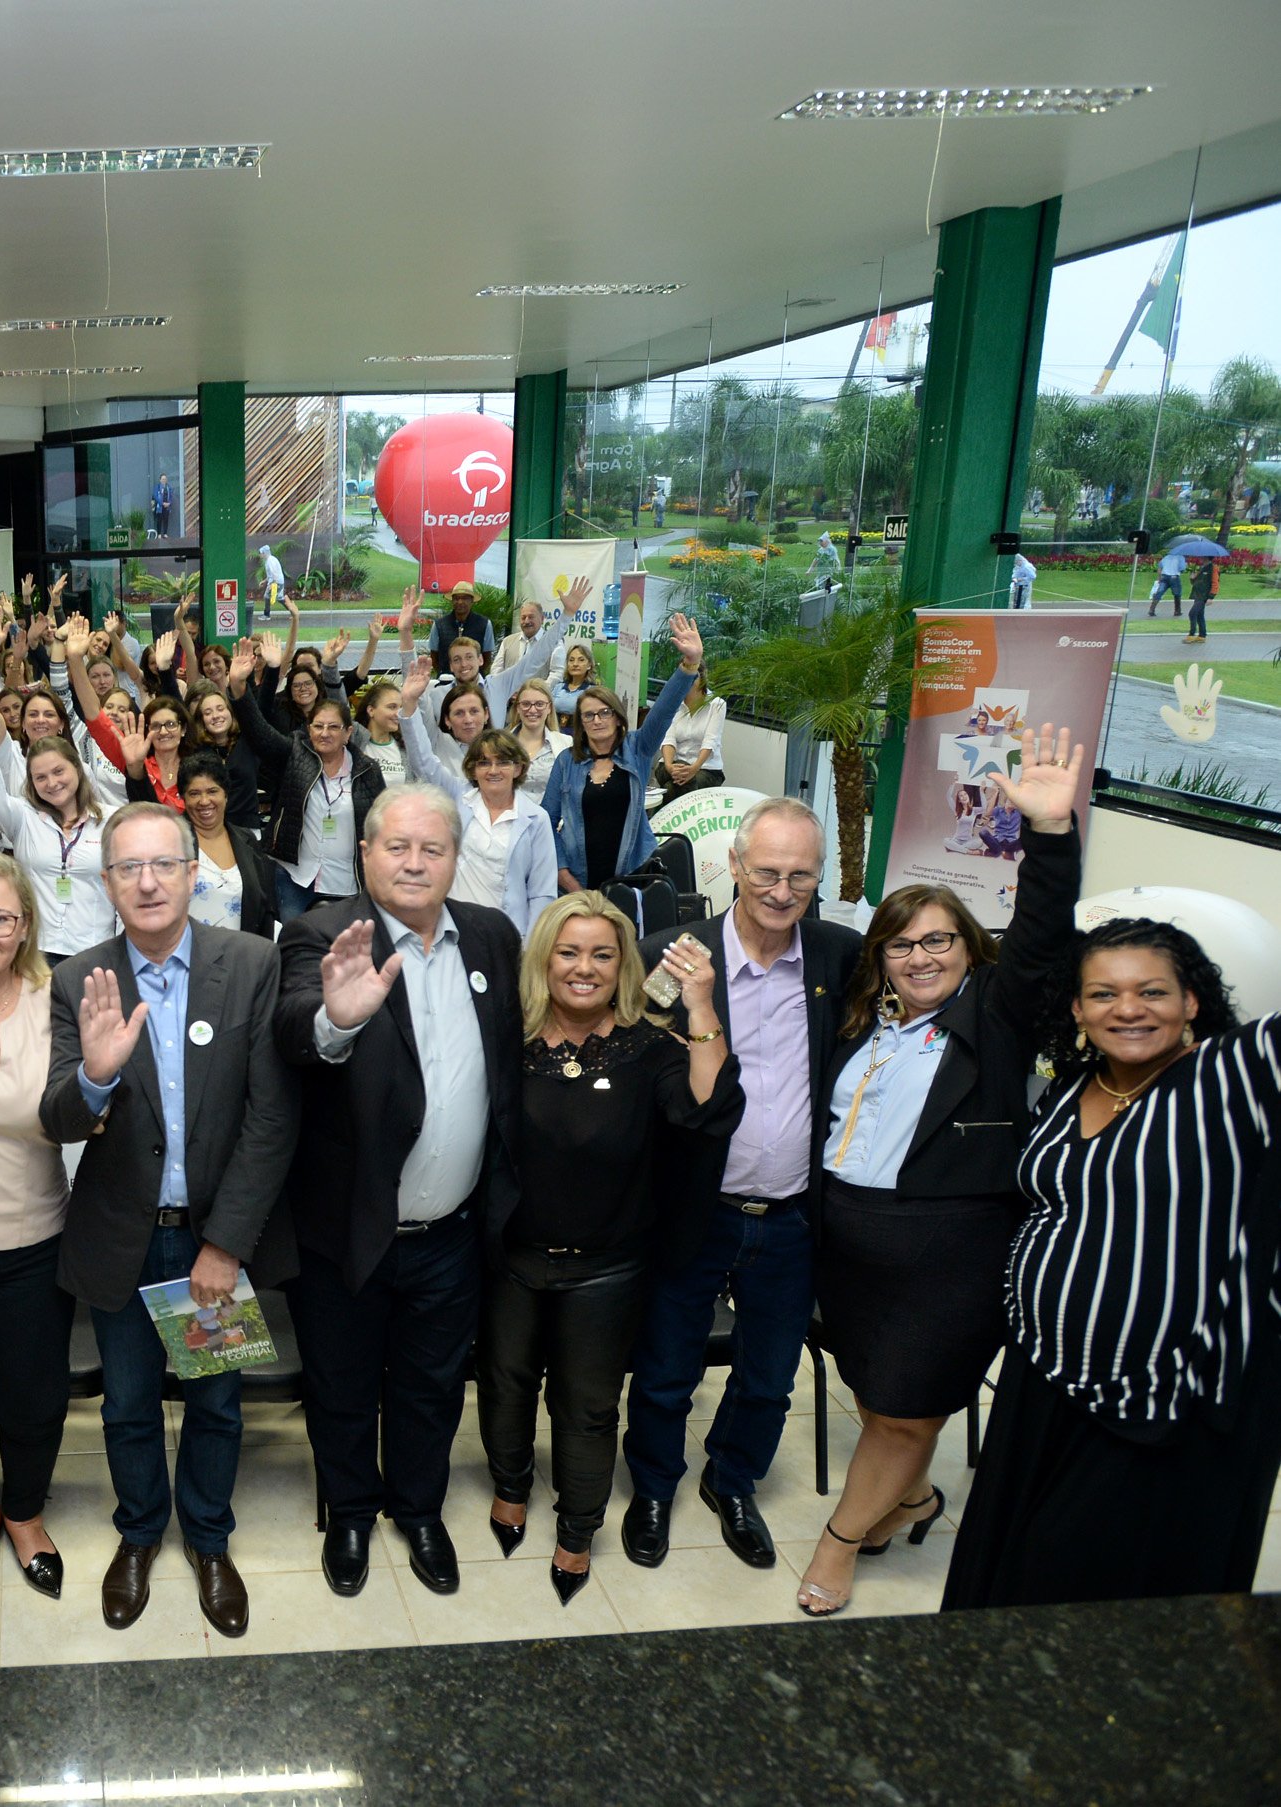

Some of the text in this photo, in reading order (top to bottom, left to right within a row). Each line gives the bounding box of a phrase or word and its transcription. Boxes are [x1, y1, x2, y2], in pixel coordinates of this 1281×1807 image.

[424, 510, 510, 526] bradesco
[109, 533, 128, 544] SAÍDA
[554, 608, 596, 624] ORGS
[923, 637, 974, 648] SomosCoop
[922, 646, 966, 655] Excelência
[724, 798, 734, 809] E
[912, 864, 946, 875] Compartilhe
[954, 872, 978, 880] grandes
[949, 879, 986, 889] cooperativa.
[228, 1347, 272, 1361] COTRIJAL
